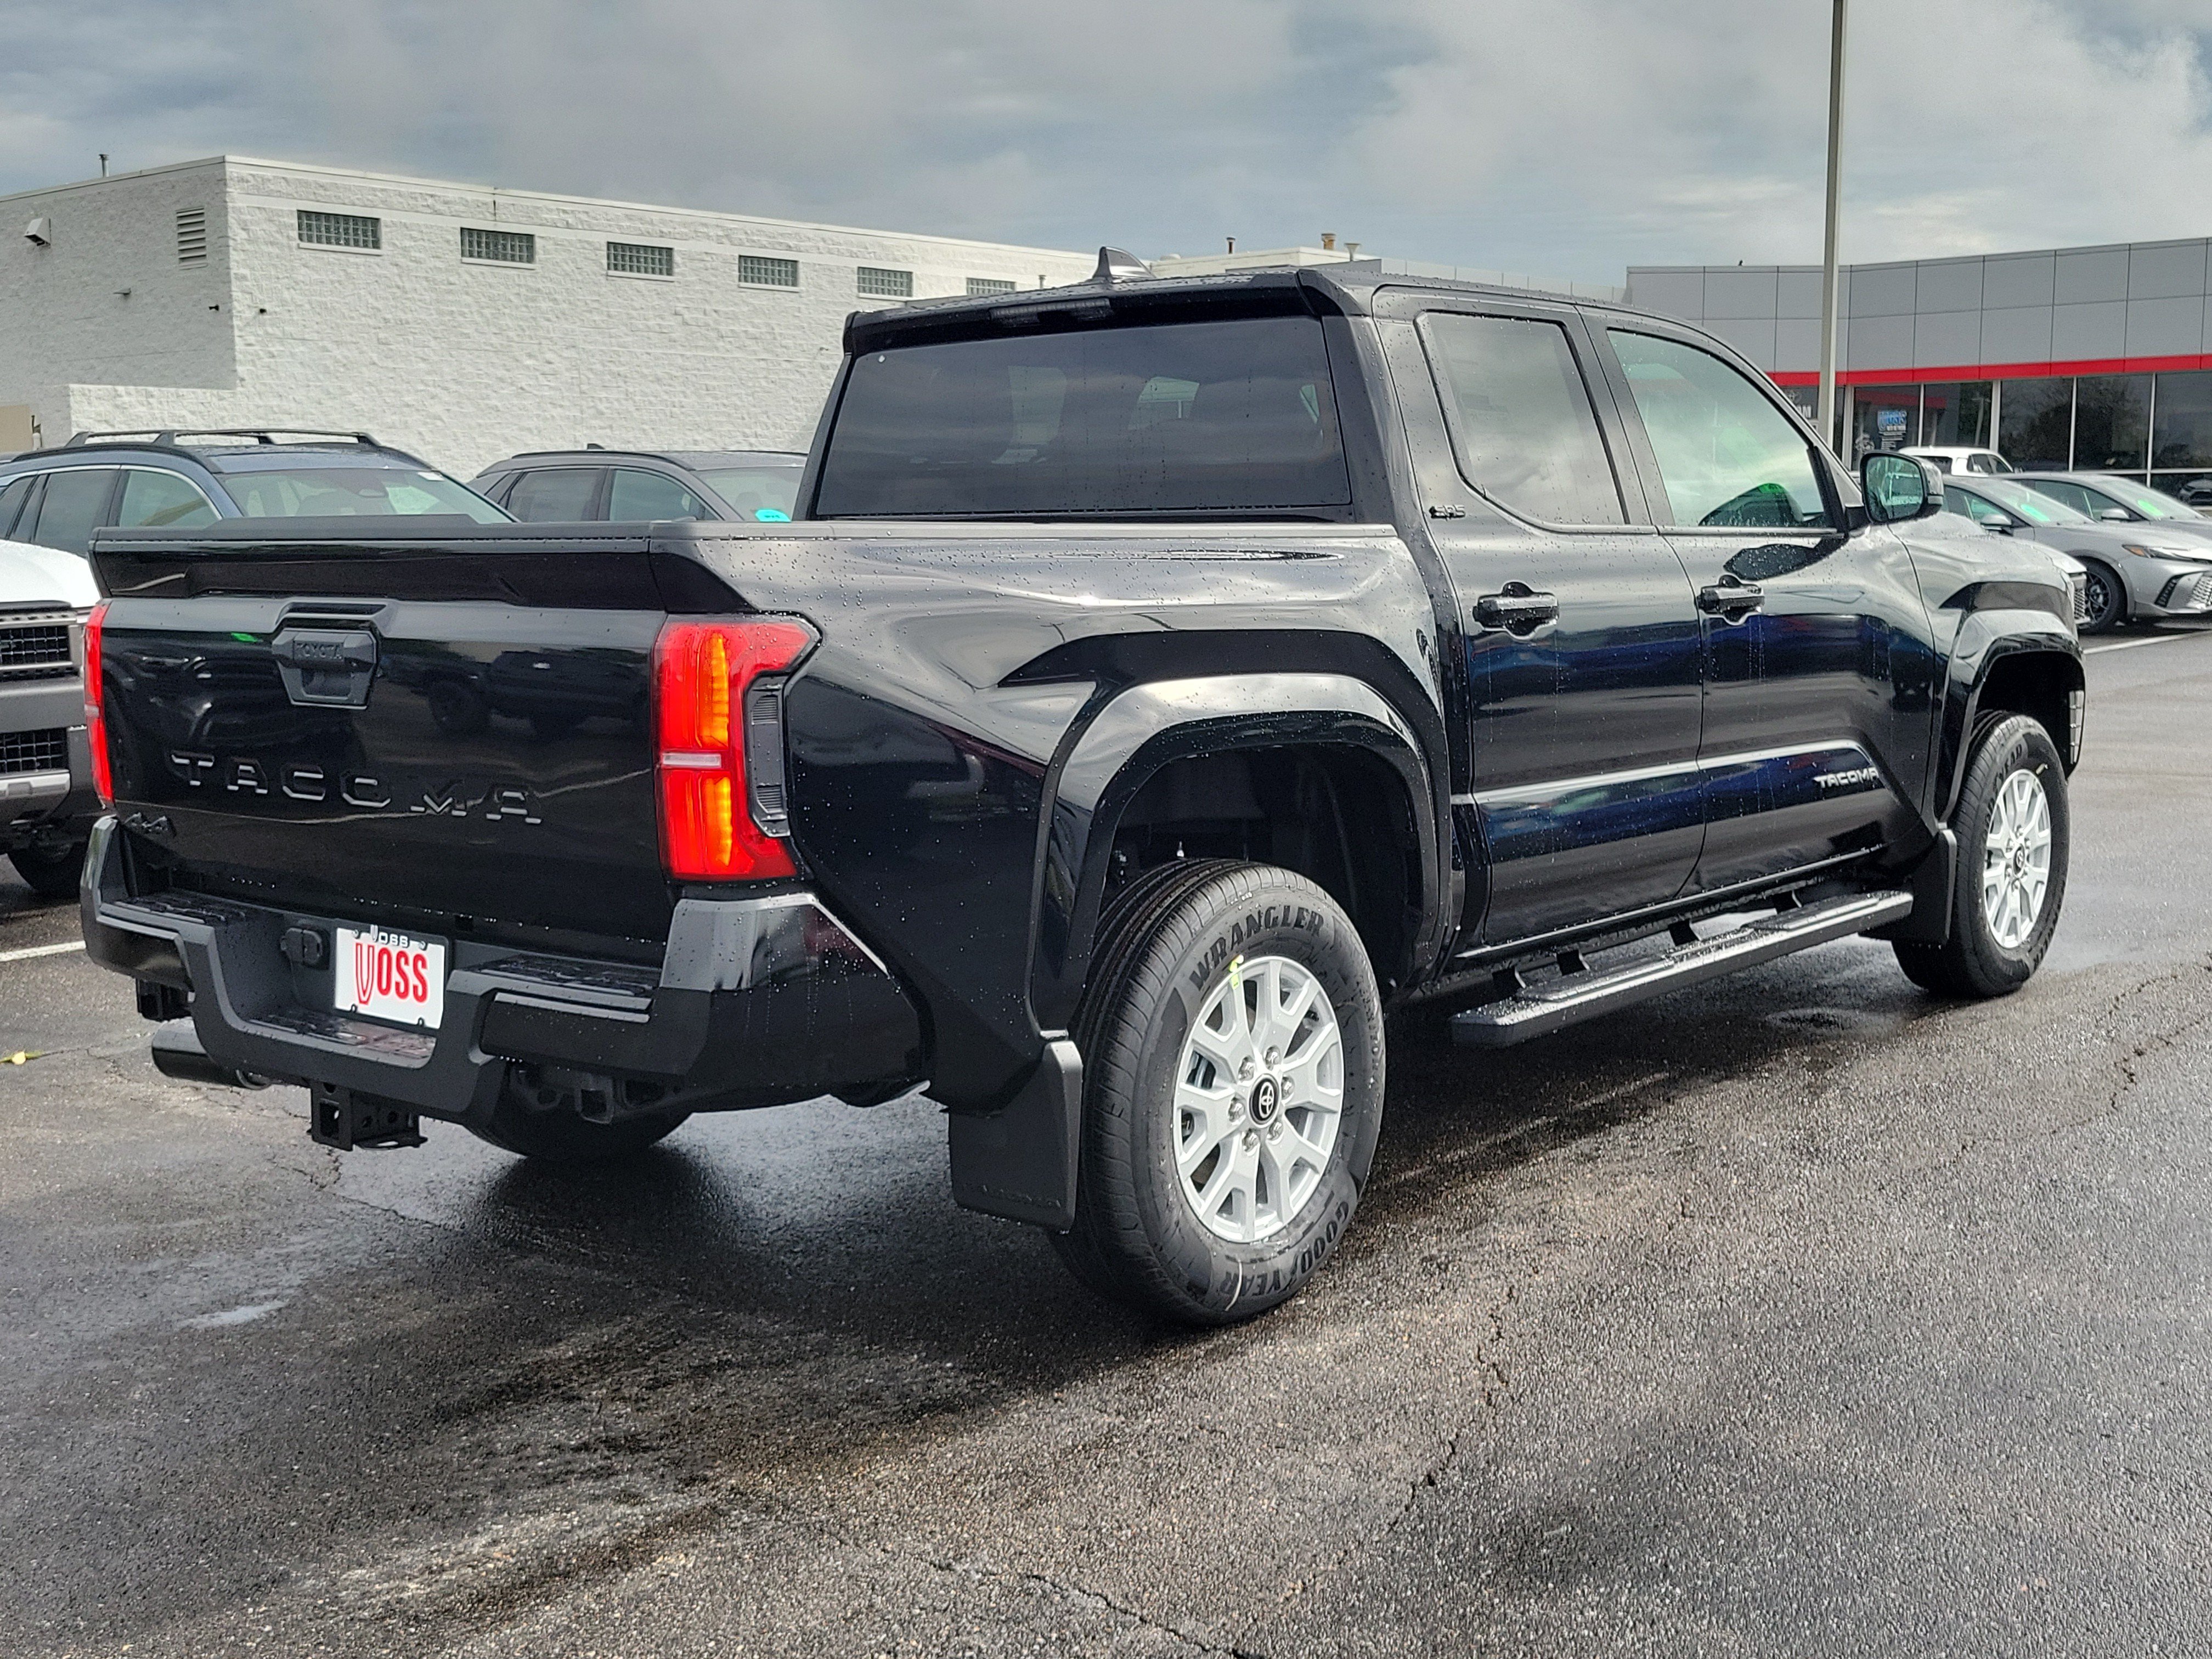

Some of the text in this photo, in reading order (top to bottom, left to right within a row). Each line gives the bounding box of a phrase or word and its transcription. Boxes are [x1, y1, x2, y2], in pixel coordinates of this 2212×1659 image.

[295, 641, 342, 660] TOYOTA
[171, 749, 542, 825] TACOMA
[1813, 767, 1880, 788] TACOMA
[370, 924, 408, 947] VOSS
[1189, 905, 1324, 991] WRANGLER
[356, 943, 428, 1005] VOSS
[1220, 1201, 1349, 1297] GOODYEAR
